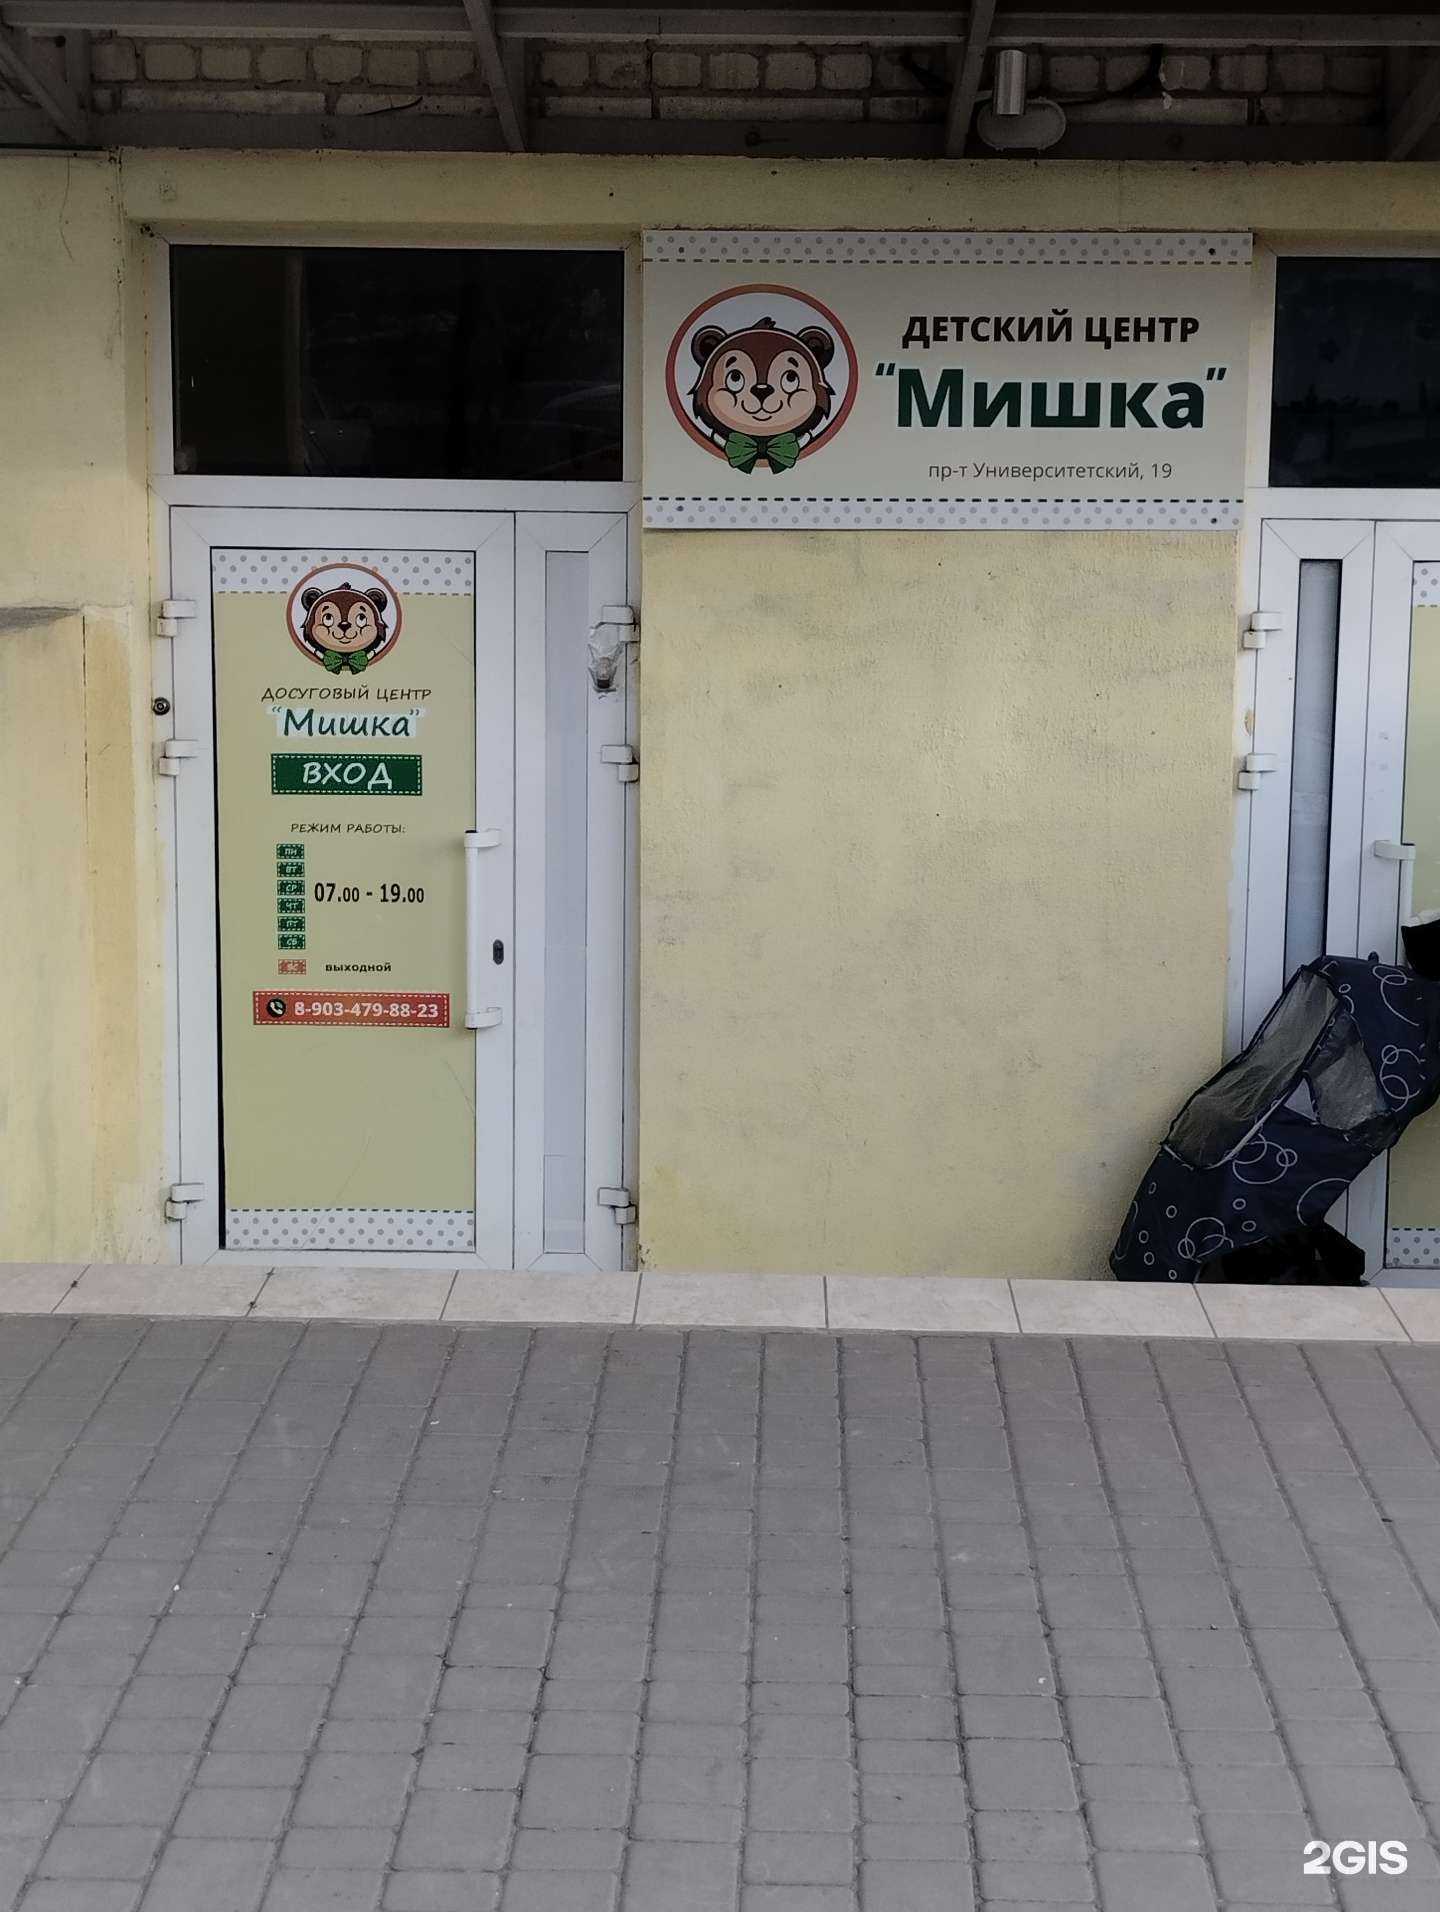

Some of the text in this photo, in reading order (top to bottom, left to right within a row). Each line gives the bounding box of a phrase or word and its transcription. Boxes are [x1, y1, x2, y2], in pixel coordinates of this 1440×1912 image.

[902, 308, 1199, 349] ДЕТСКИЙ ЦЕНТР
[928, 462, 1172, 482] пр-т Университетский, 19
[261, 684, 432, 703] ДОСУГОВЫЙ ЦЕНТР
[302, 761, 393, 791] ВХОД
[291, 823, 406, 834] РЕЖИМ РАБОТЫ:
[314, 882, 360, 902] 07.00
[380, 883, 425, 903] 19.00
[294, 1001, 439, 1018] 8-903-479-88-23
